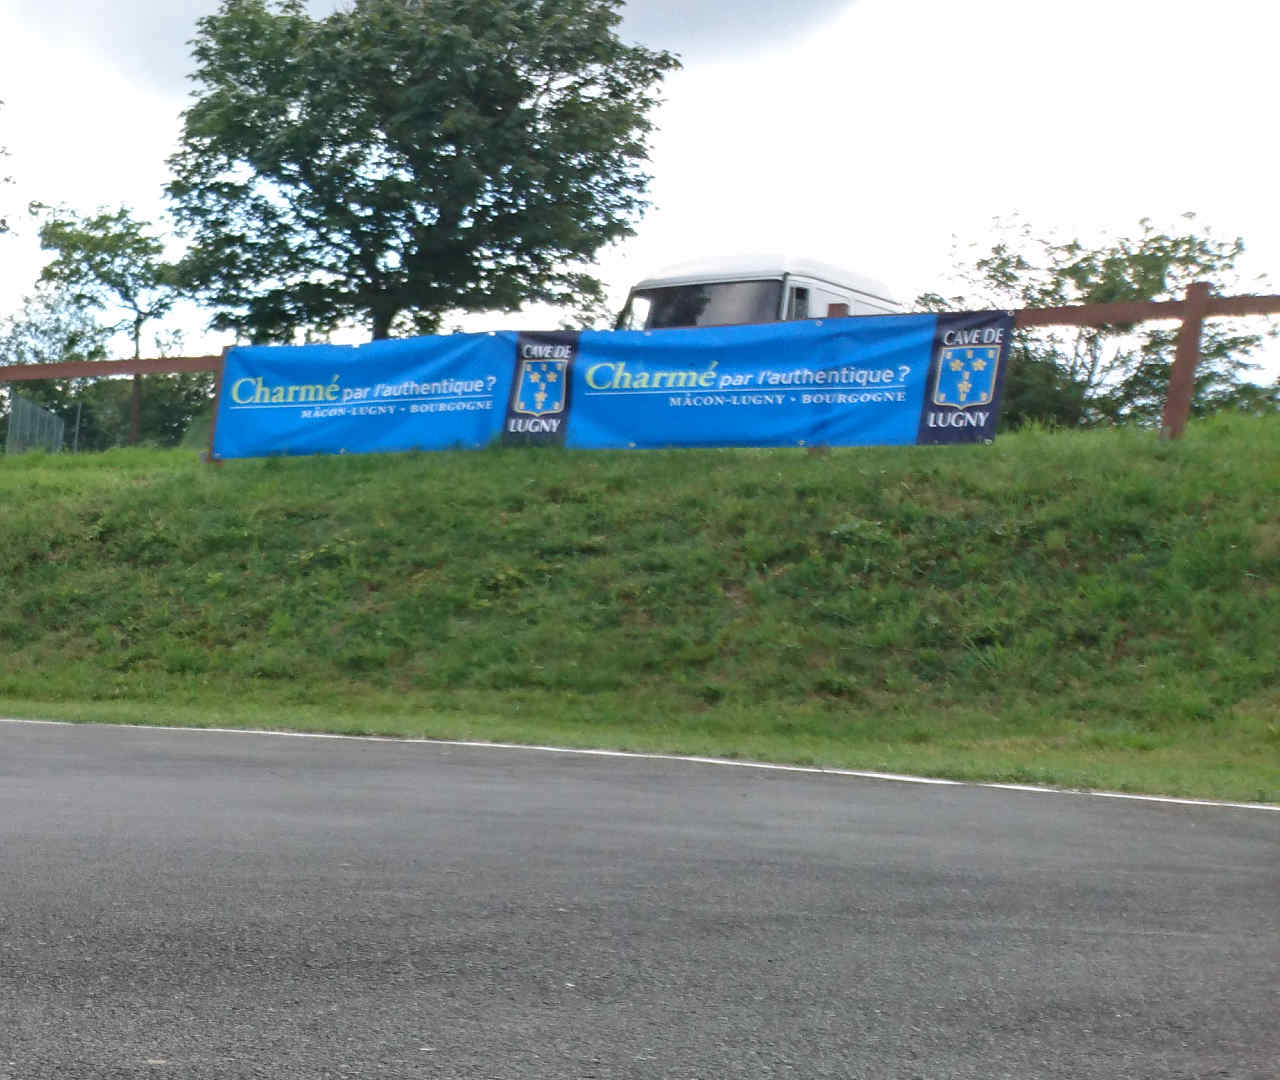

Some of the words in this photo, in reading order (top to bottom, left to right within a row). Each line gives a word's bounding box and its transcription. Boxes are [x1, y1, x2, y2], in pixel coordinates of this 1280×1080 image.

[943, 329, 981, 346] CAVE
[983, 328, 1005, 344] DE
[523, 344, 553, 359] CAVE
[553, 344, 572, 358] DE
[585, 360, 719, 390] Charmé
[719, 373, 753, 389] par
[231, 374, 340, 404] Charmé
[343, 386, 370, 402] par
[801, 391, 906, 405] BOURGOGNE
[409, 400, 494, 414] BOURGOGNE
[509, 418, 561, 433] LUGNY
[928, 411, 990, 428] LUGNY
